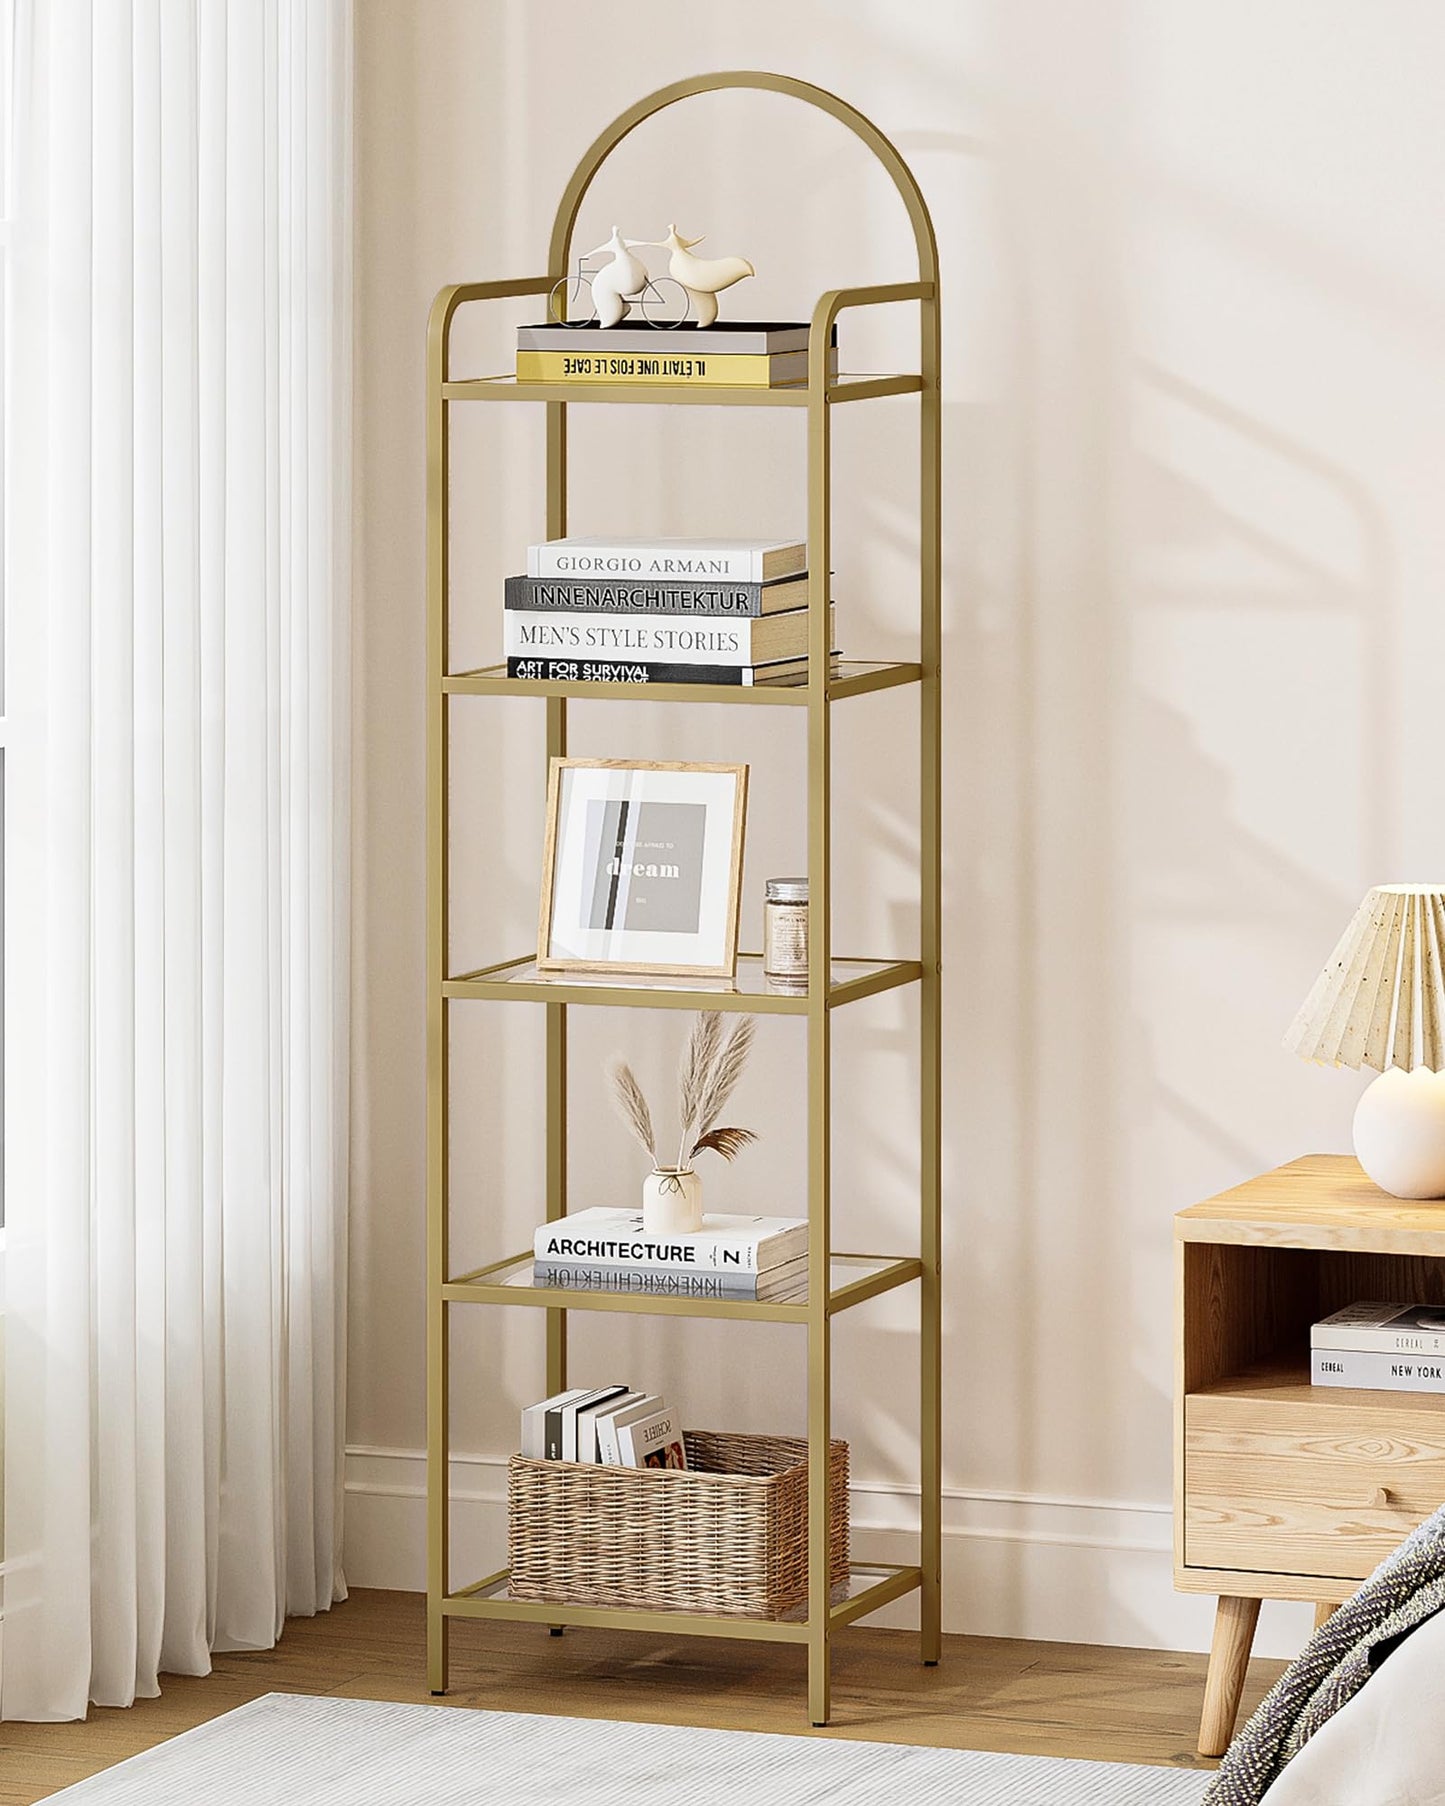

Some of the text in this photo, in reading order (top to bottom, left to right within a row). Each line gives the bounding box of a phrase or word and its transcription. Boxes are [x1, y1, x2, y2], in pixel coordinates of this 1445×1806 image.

[563, 358, 706, 378] IL ÉTAIT UNE FOIS LE CAFÉ
[556, 556, 730, 574] GIORGIO ARMANI
[534, 585, 749, 611] INNENARCHITEKTUR
[520, 625, 739, 652] MEN'S STYLE STORIES
[516, 660, 649, 678] ART FOR SURVIVAL
[547, 1238, 695, 1262] ARCHITECTURE
[1395, 1338, 1423, 1350] CEREAL
[1321, 1362, 1344, 1373] CEREAL
[1391, 1365, 1442, 1379] NEW YORK
